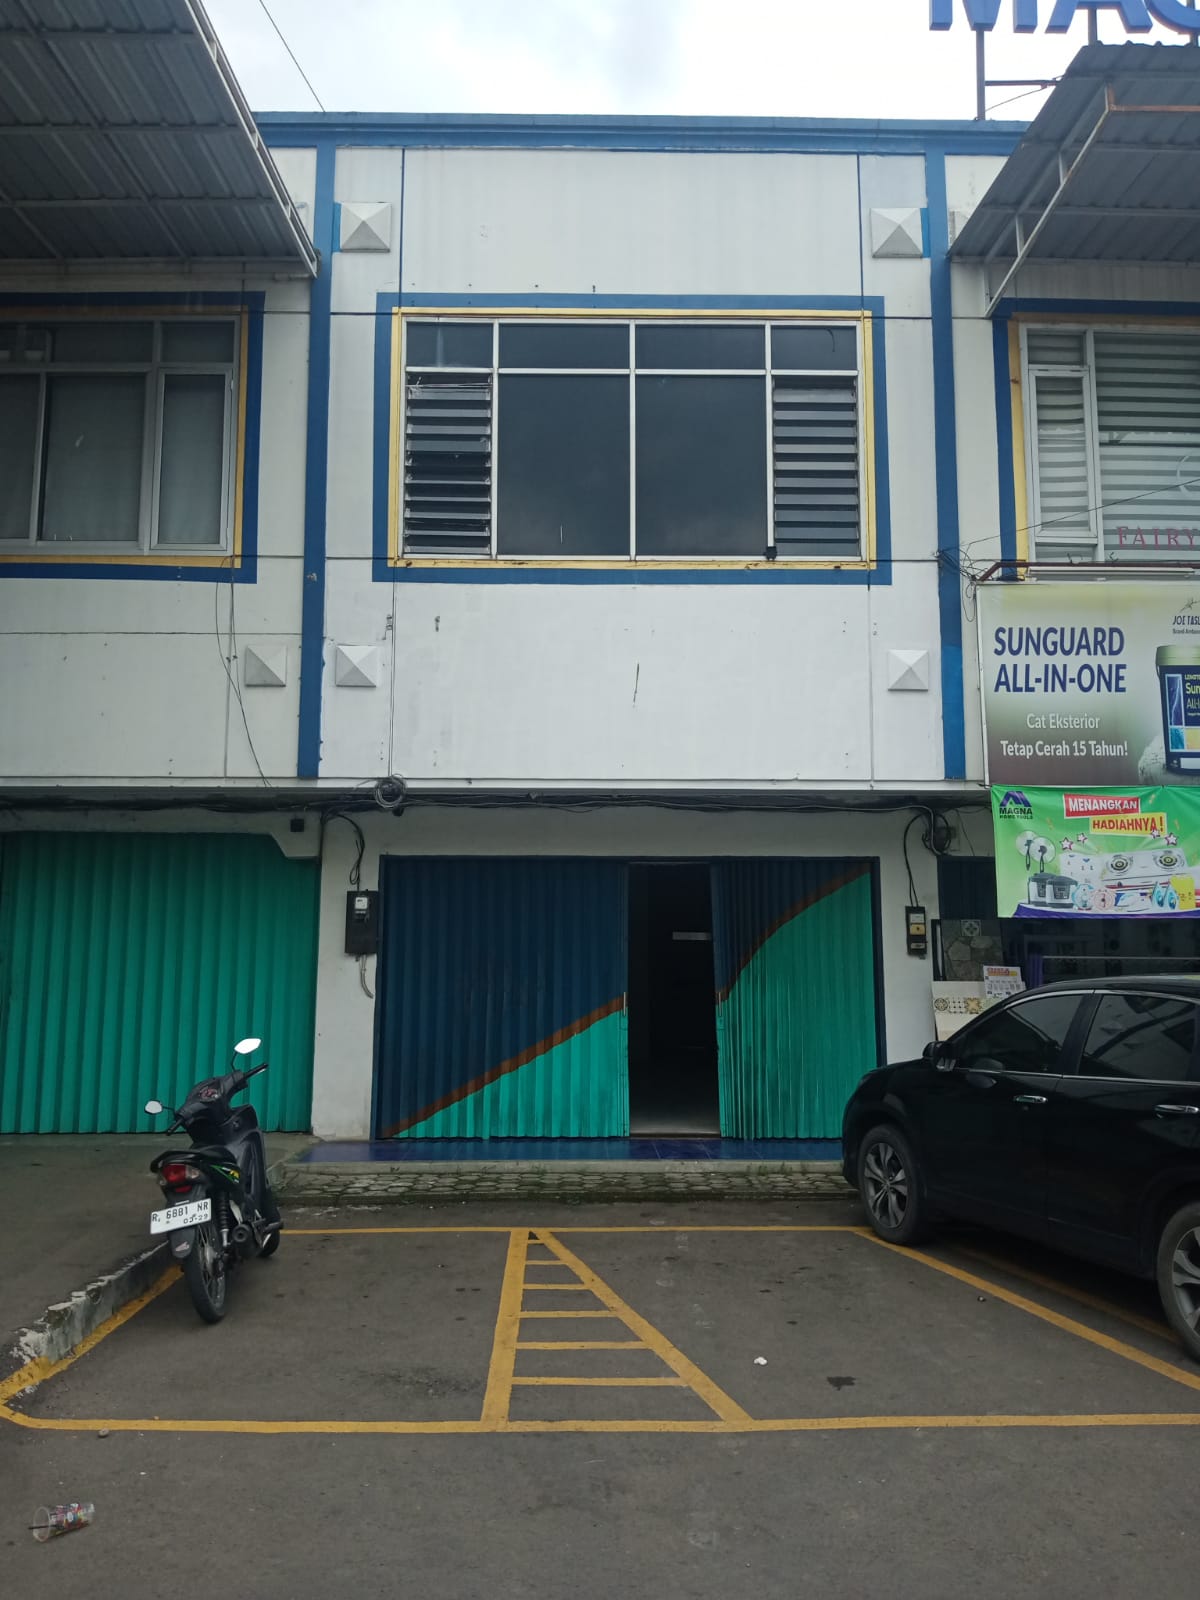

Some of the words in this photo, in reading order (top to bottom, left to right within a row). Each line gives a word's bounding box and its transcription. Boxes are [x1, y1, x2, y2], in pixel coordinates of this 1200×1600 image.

[1117, 526, 1199, 550] FAIRY
[994, 626, 1125, 656] SUNGUARD
[994, 663, 1127, 693] ALL-IN-ONE
[1027, 713, 1047, 729] Cat
[1049, 713, 1100, 729] Eksterior
[1000, 741, 1033, 759] Tetap
[1035, 741, 1070, 756] Cerah
[1073, 741, 1087, 756] 15
[1088, 741, 1128, 756] Tahun!
[1000, 807, 1033, 815] MAGNA
[1068, 798, 1137, 812] MENANGKAN
[166, 1206, 188, 1220] 6881
[197, 1201, 209, 1212] NR
